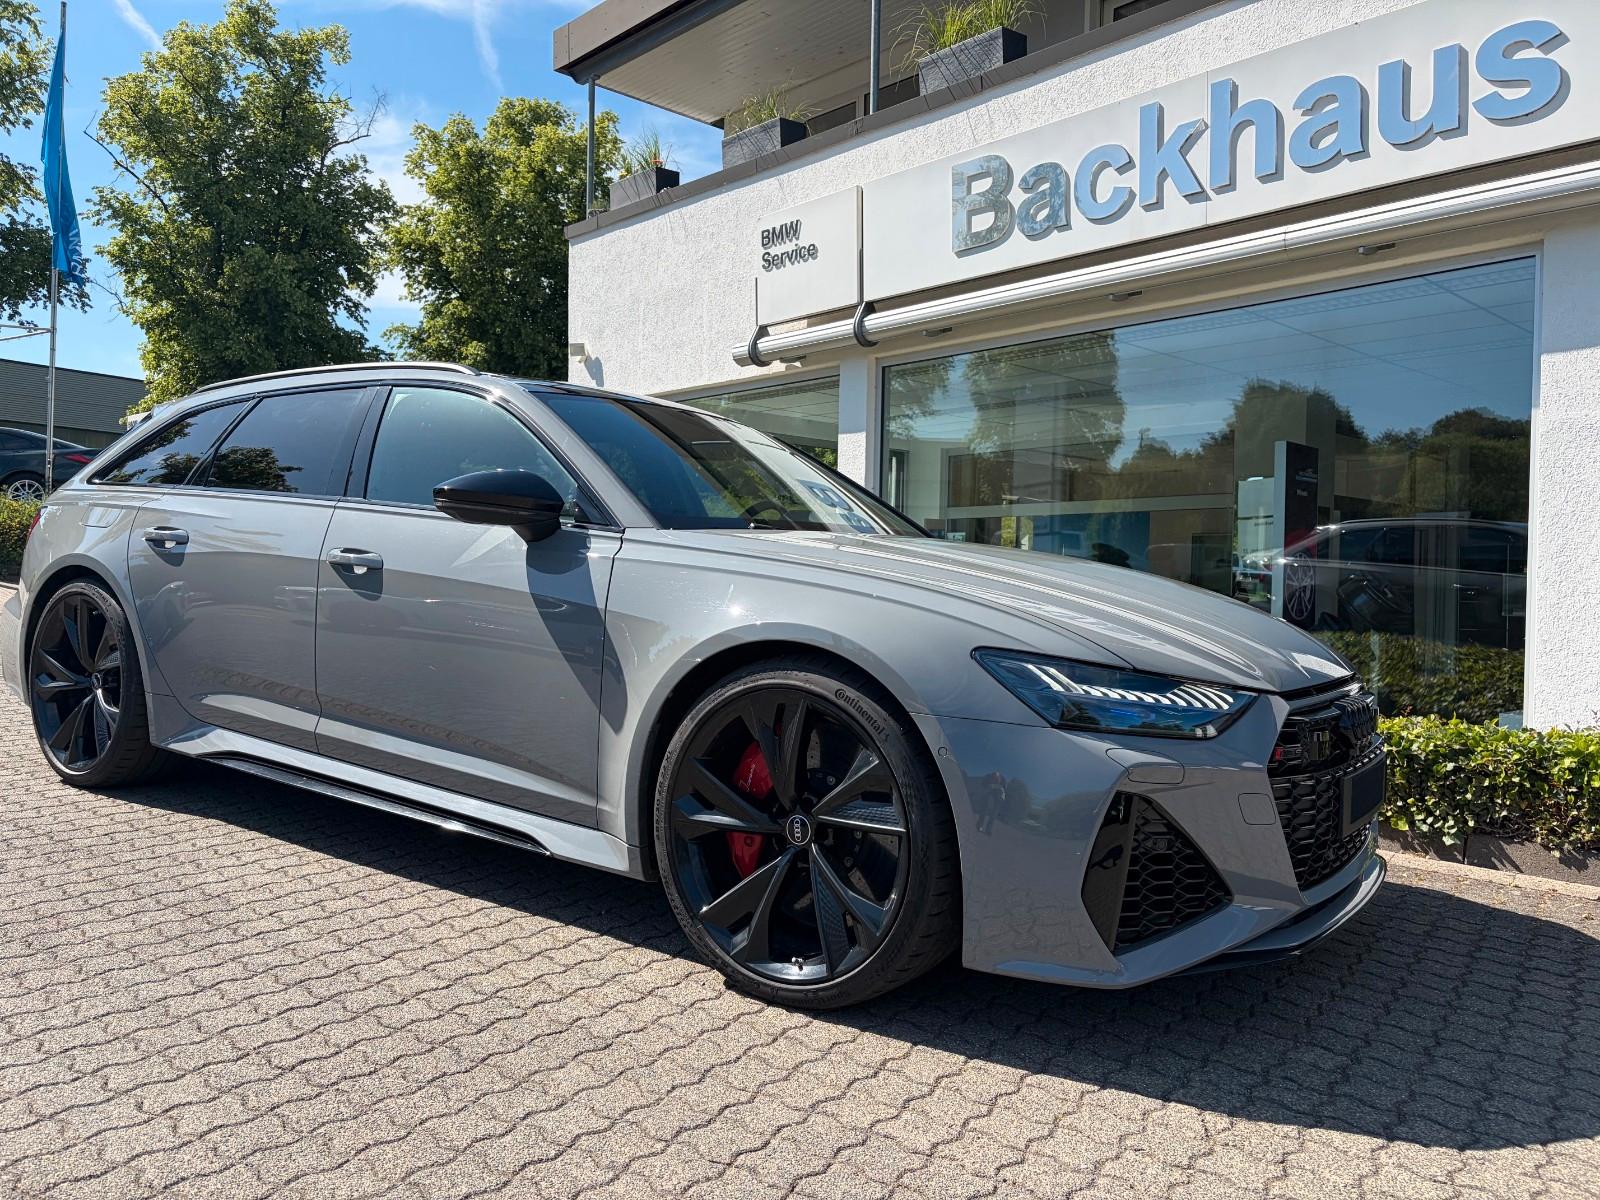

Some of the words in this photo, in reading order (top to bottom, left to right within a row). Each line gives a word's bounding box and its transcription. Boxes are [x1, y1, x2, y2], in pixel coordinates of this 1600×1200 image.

[951, 19, 1567, 256] Backhaus
[761, 219, 801, 248] BMW
[761, 243, 818, 272] Service
[834, 688, 886, 735] Continental
